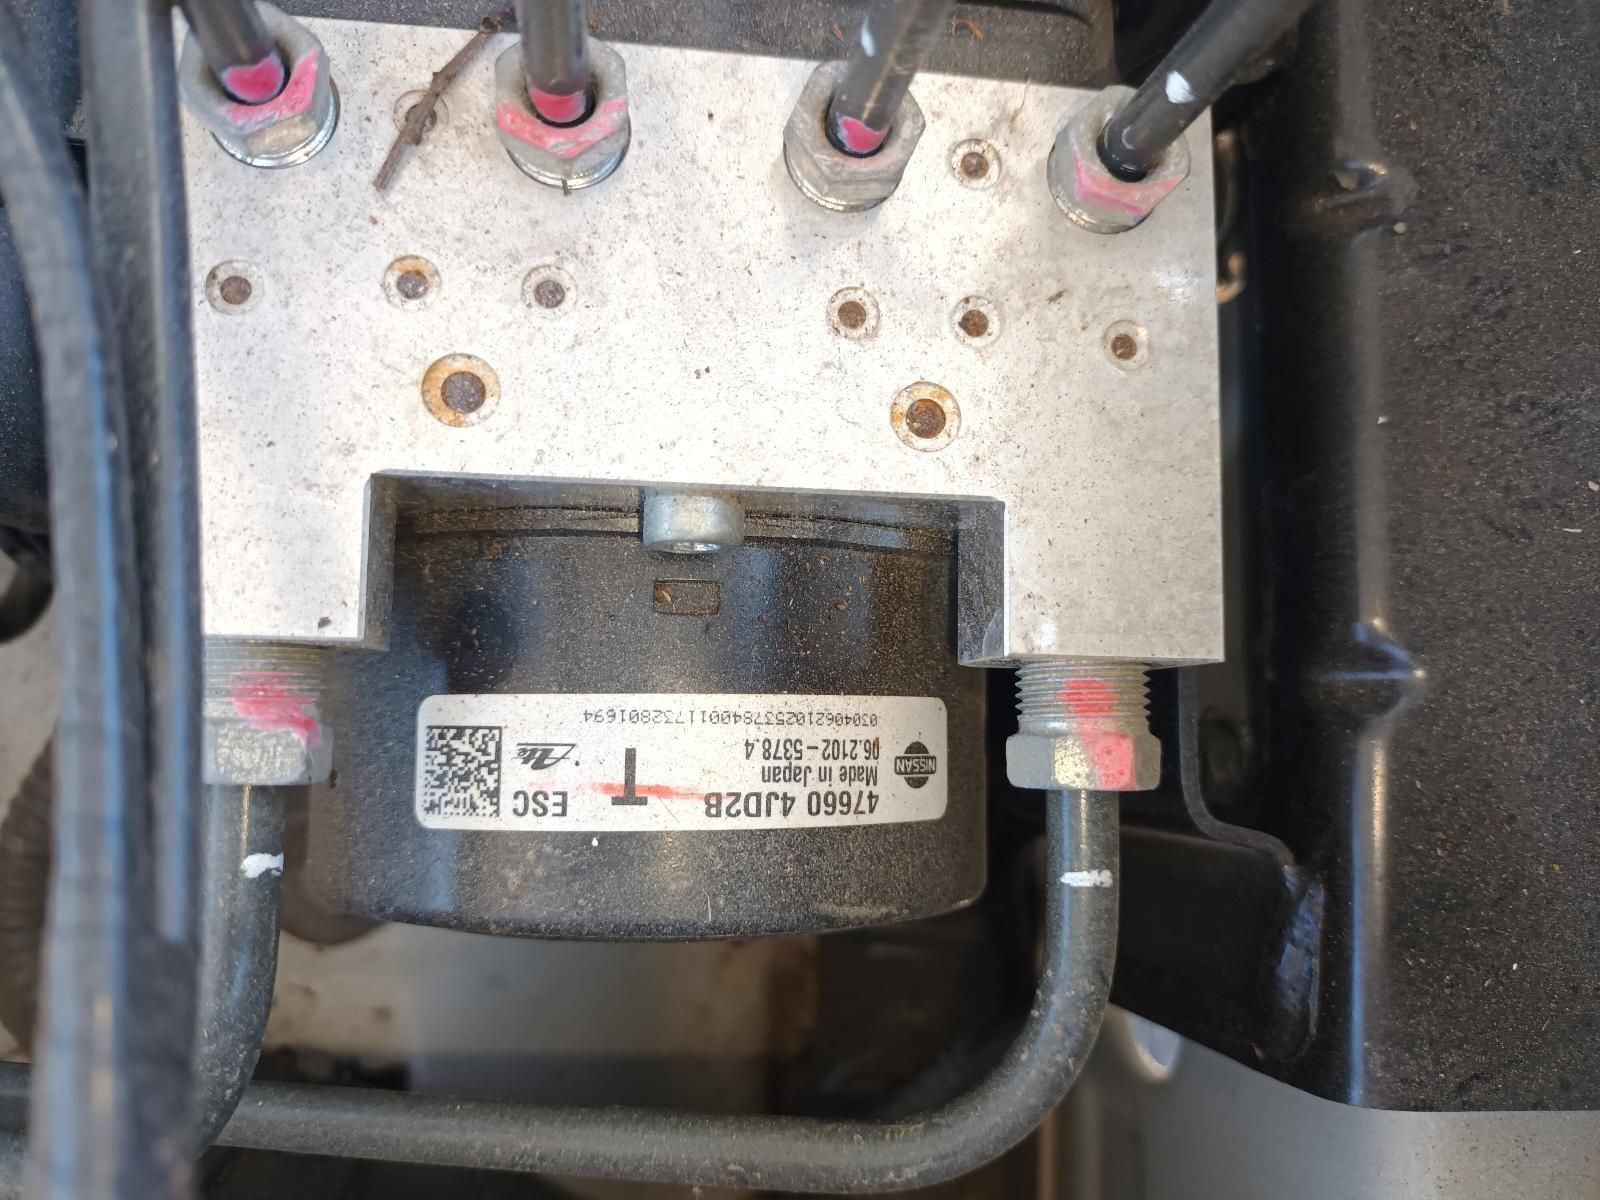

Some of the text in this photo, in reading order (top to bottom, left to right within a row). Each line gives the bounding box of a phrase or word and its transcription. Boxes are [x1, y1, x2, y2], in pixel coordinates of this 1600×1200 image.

[611, 747, 648, 807] T
[761, 761, 878, 787] Made in Japan
[895, 757, 937, 774] NISSAN
[512, 790, 568, 818] ESC
[703, 790, 879, 819] 47660 4JD2B
